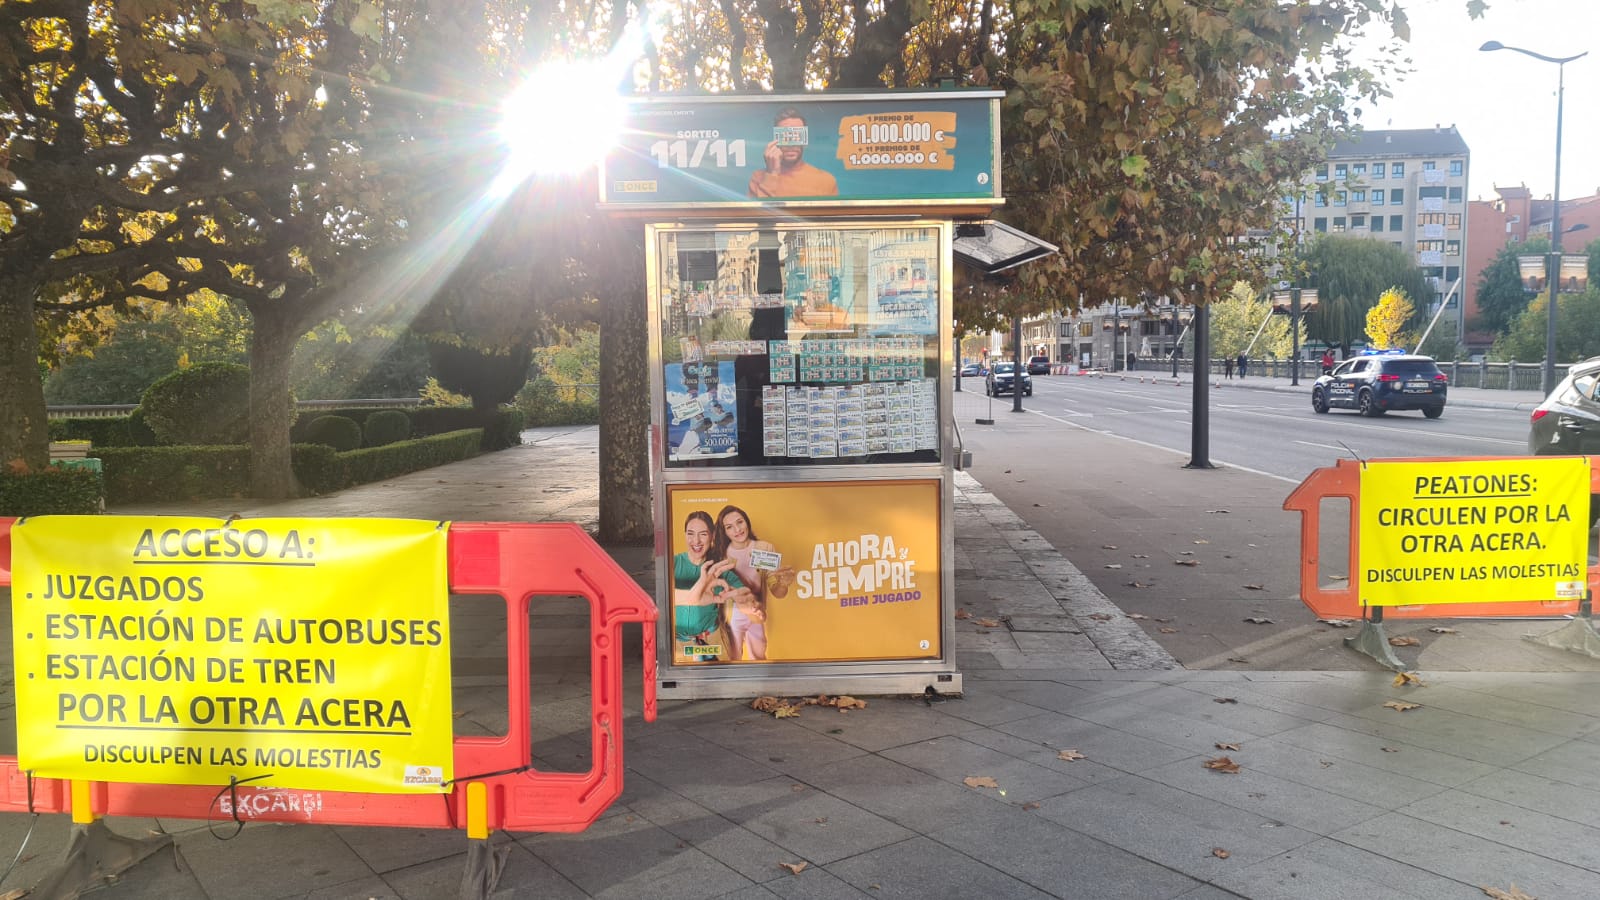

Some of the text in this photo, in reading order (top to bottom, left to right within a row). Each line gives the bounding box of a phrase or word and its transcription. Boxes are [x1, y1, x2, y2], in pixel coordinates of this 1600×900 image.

[677, 129, 720, 139] SORTEO
[851, 122, 944, 144] 11.000.000 €
[650, 138, 746, 169] 11/11
[849, 152, 925, 165] 1.000.000
[626, 183, 655, 191] ONCE
[1415, 474, 1538, 495] PEATONES:
[1378, 504, 1571, 527] CIRCULEN POR LA
[133, 529, 315, 559] ACCESO A:
[811, 534, 897, 569] AHORA
[1401, 532, 1547, 553] OTRA ACERA.
[796, 559, 916, 600] SIEMPRE
[1367, 562, 1580, 583] DISCULPEN LAS MOLESTIAS
[43, 574, 204, 602] JUZGADOS
[840, 590, 922, 608] BIEN JUGADO
[46, 609, 442, 646] ESTACIÓN DE AUTOBUSES
[695, 646, 719, 655] ONCE
[46, 649, 336, 685] ESTACIÓN DE TREN
[58, 693, 412, 728] POR LA OTRA ACERA
[84, 744, 382, 769] DISCULPEN LAS MOLESTIAS
